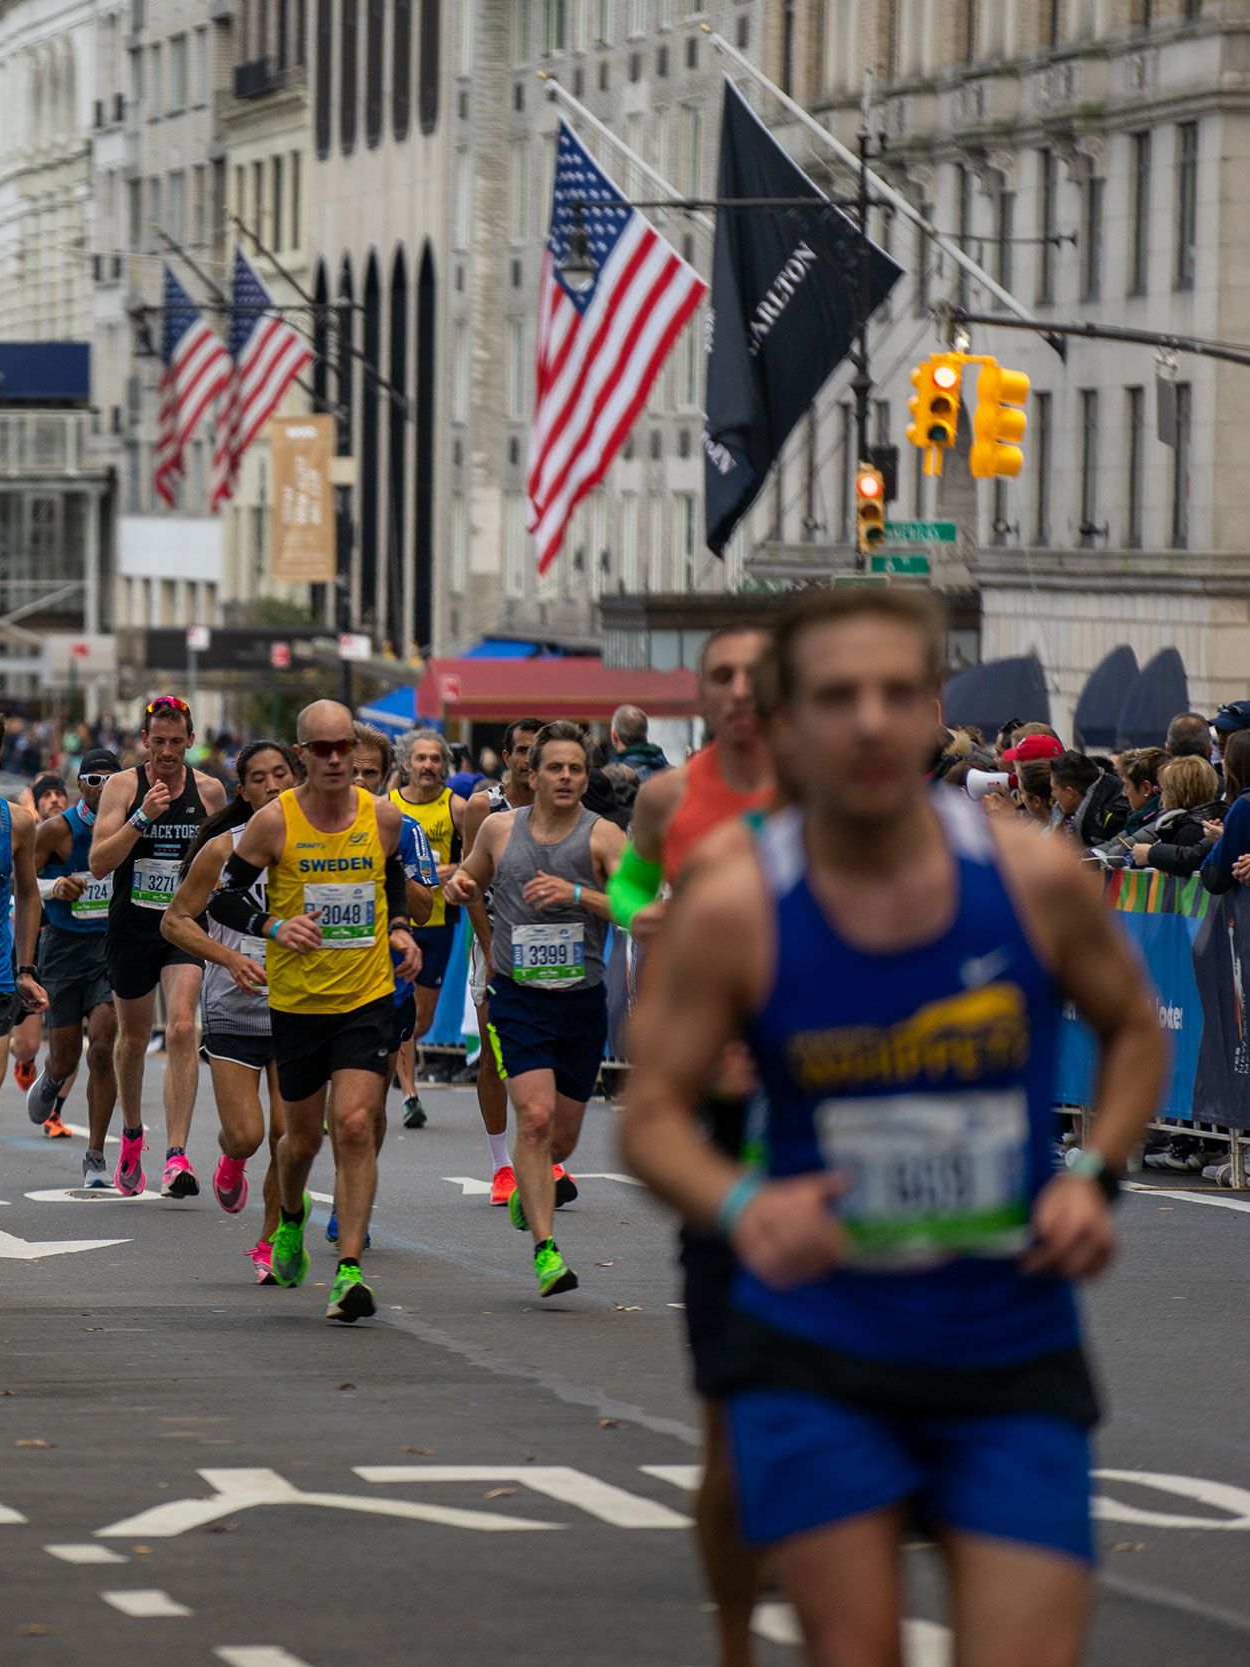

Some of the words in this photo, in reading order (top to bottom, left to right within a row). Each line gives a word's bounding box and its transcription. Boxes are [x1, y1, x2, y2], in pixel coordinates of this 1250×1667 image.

[142, 824, 201, 840] LACKTOES
[299, 857, 374, 873] SWEDEN
[88, 884, 108, 900] 724
[148, 875, 175, 893] 3271
[322, 904, 362, 925] 3048
[529, 944, 567, 966] 3399
